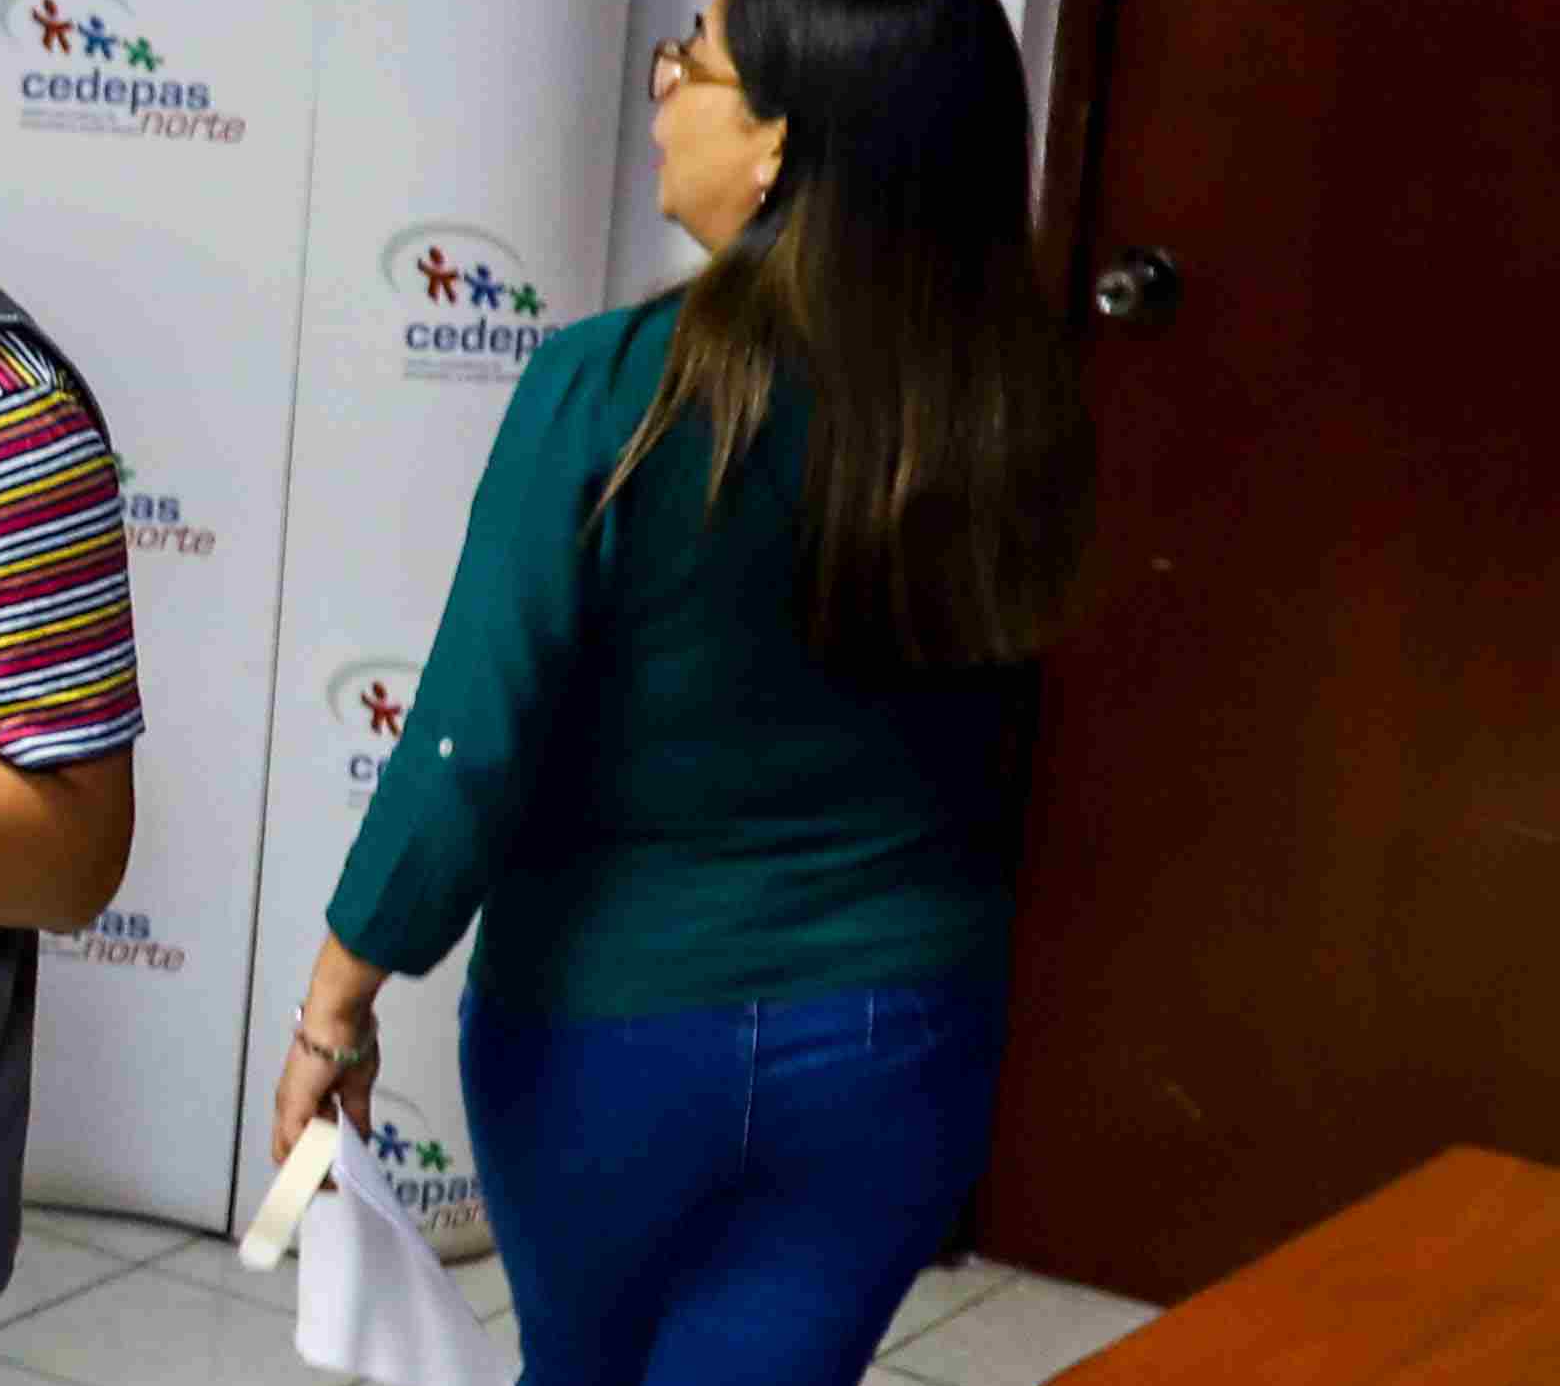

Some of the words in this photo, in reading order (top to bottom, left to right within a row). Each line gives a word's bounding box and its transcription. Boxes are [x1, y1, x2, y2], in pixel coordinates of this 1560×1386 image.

[22, 69, 210, 115] cedepas
[140, 107, 246, 145] norte
[406, 317, 559, 362] cedep
